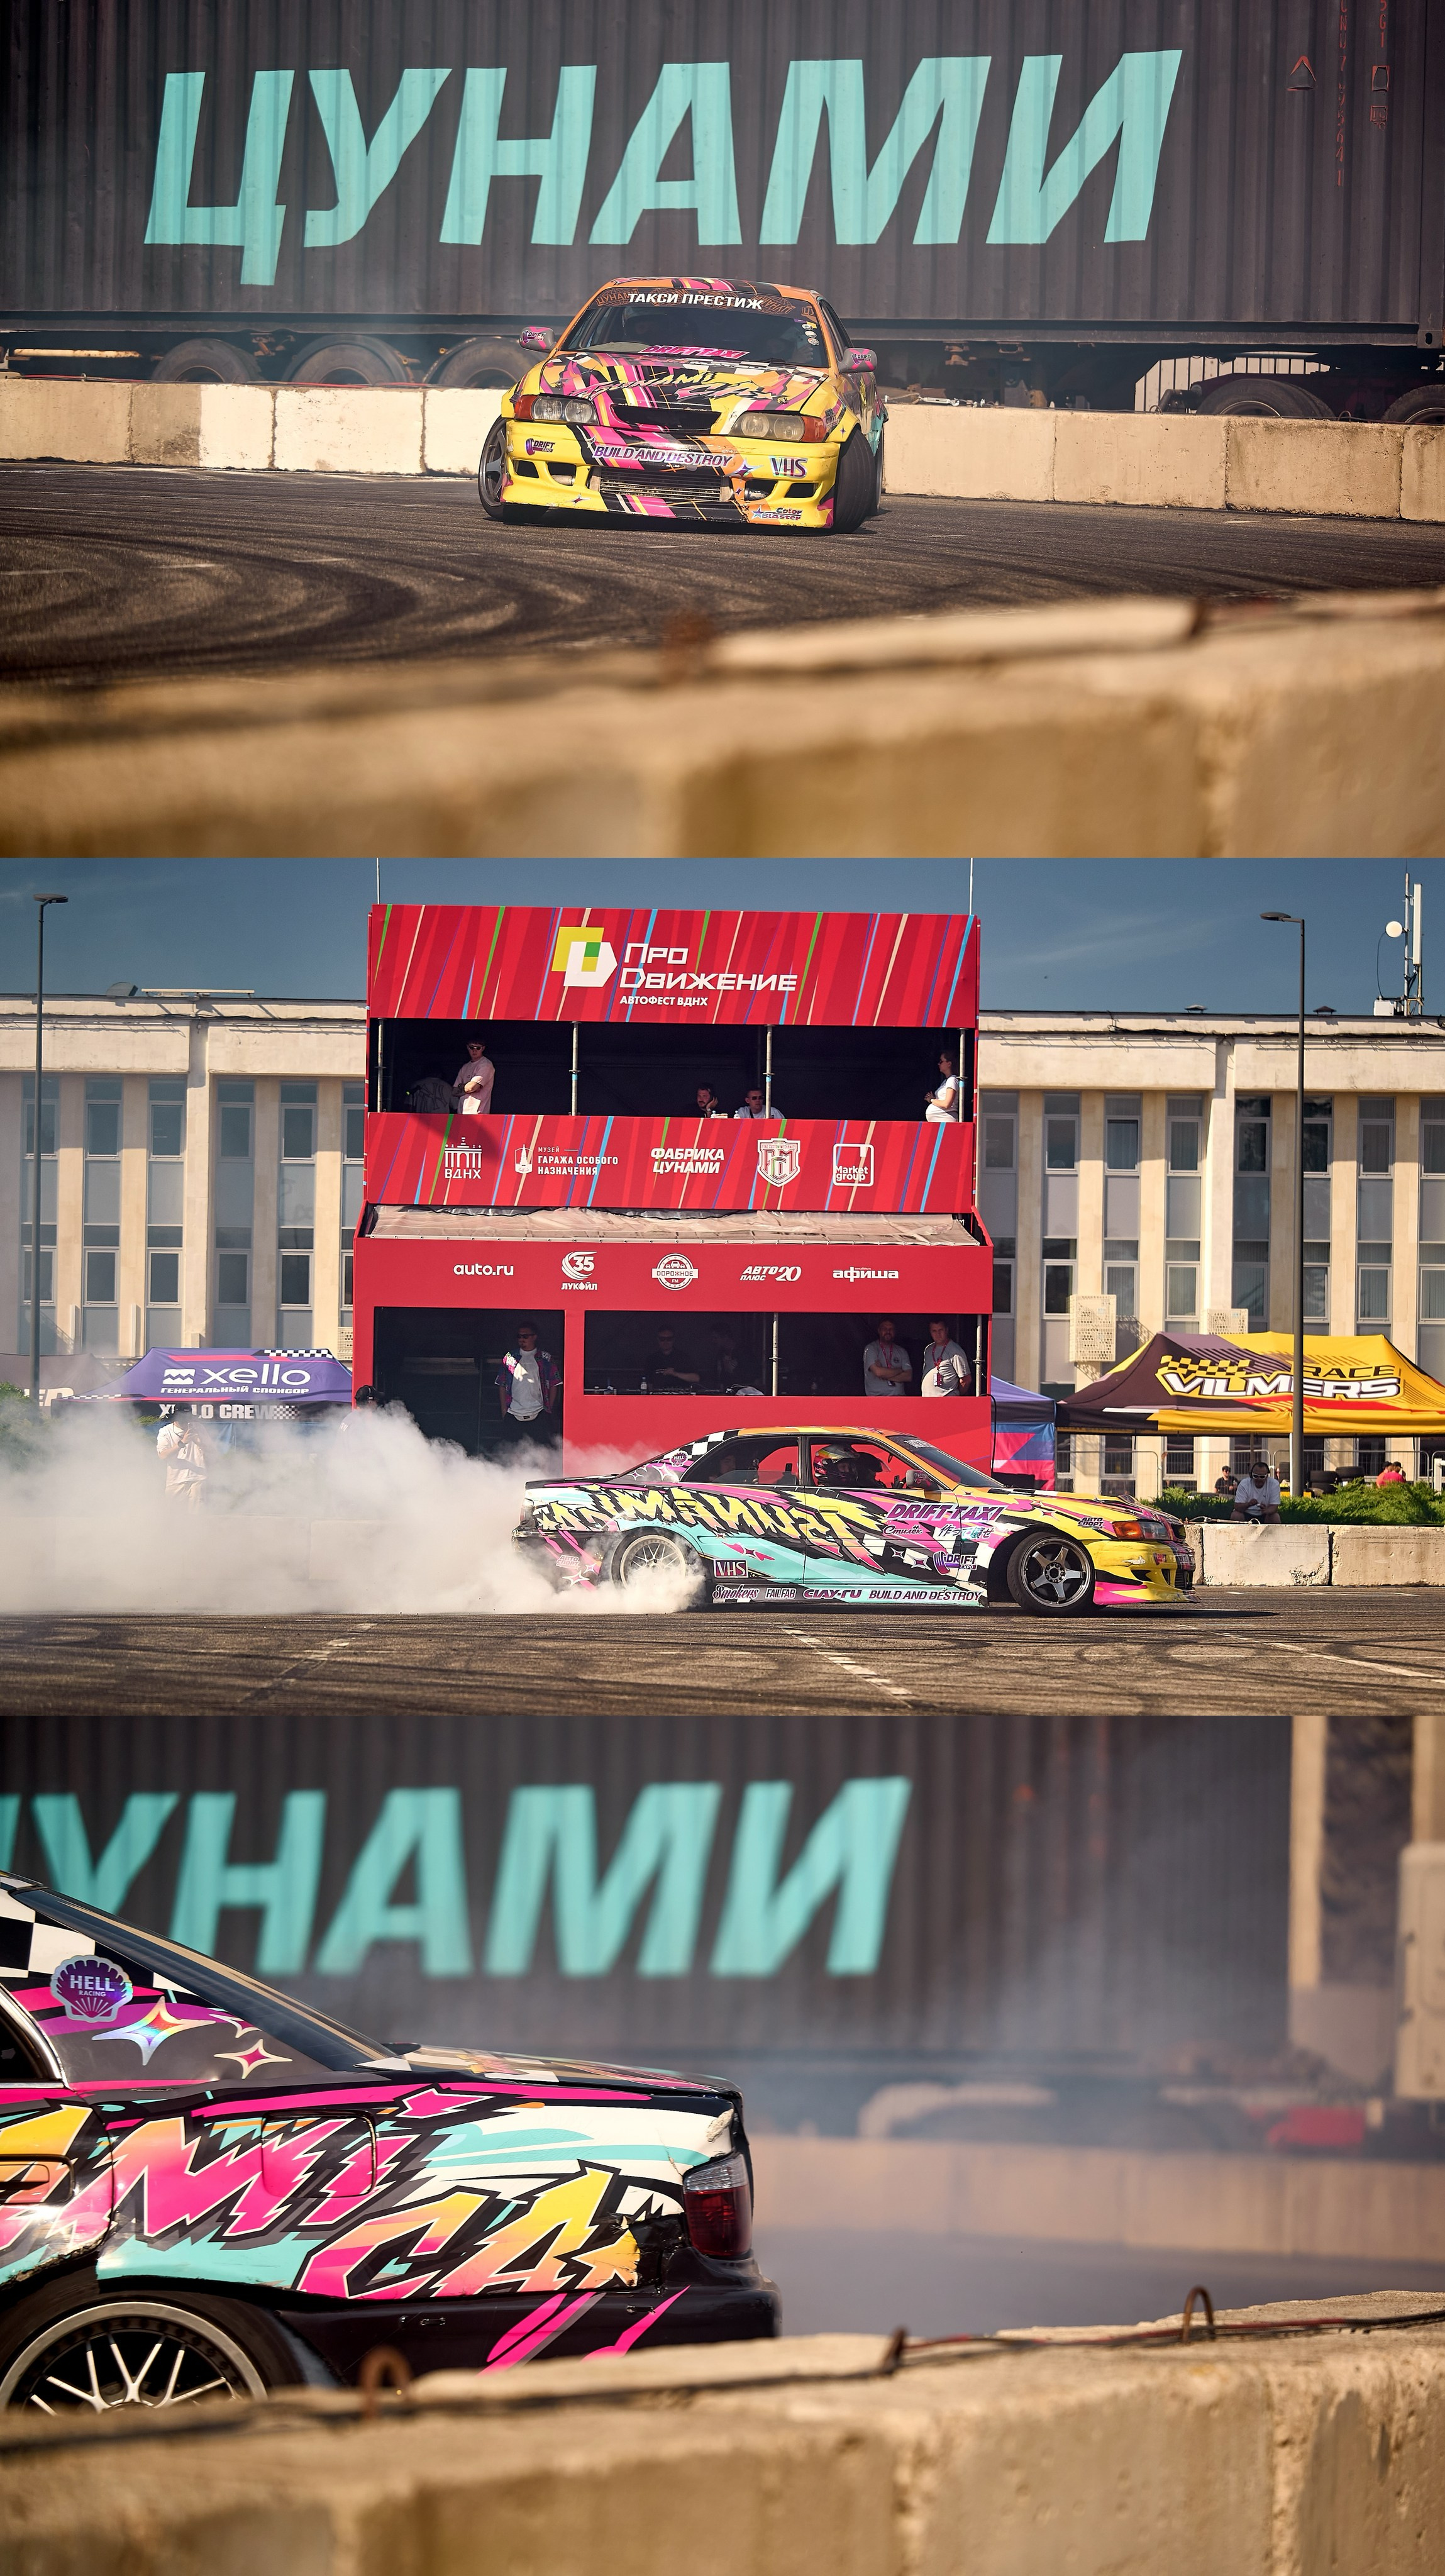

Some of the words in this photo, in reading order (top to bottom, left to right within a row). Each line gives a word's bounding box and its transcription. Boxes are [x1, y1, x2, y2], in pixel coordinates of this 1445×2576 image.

[145, 50, 1182, 286] ЦУНАМИ
[629, 293, 678, 304] ТАКСИ
[682, 294, 765, 310] ПРЕСТИЖ
[533, 440, 556, 449] DRIFT
[594, 446, 634, 458] BUILD
[634, 450, 664, 462] AND
[667, 452, 733, 467] DESTROY
[772, 457, 807, 478] VHS
[776, 507, 803, 515] Color
[619, 996, 675, 1006] АВТОФЕСТ
[677, 997, 709, 1007] ВДНХ
[538, 1155, 573, 1165] ГАРАЖА
[577, 1157, 619, 1165] ОСОБОГО
[650, 1147, 724, 1160] ФАБРИКА
[445, 1169, 482, 1180] ВДНХ
[538, 1167, 599, 1175] НАЗНАЧЕНИЯ
[653, 1162, 720, 1174] ЦУНАМИ
[835, 1165, 868, 1175] Market
[836, 1173, 866, 1182] group
[453, 1263, 514, 1275] auto.ru
[573, 1256, 595, 1272] 35
[742, 1266, 779, 1275] АВТО
[775, 1266, 802, 1282] 20
[833, 1266, 899, 1282] афиша
[201, 1363, 311, 1385] xello
[160, 1385, 250, 1394] ГЕНЕРАЛЬНЫЙ
[1163, 1374, 1402, 1398] VILMERS
[219, 1404, 275, 1419] CREW
[946, 1553, 978, 1564] DRIFT
[716, 1561, 746, 1577] VHS
[712, 1584, 759, 1599] Smokers
[869, 1590, 904, 1599] BUILD
[903, 1591, 928, 1600] AND
[929, 1591, 981, 1601] DESTROY
[0, 1777, 912, 1976] УНАМИ
[70, 1975, 115, 1992] HELL
